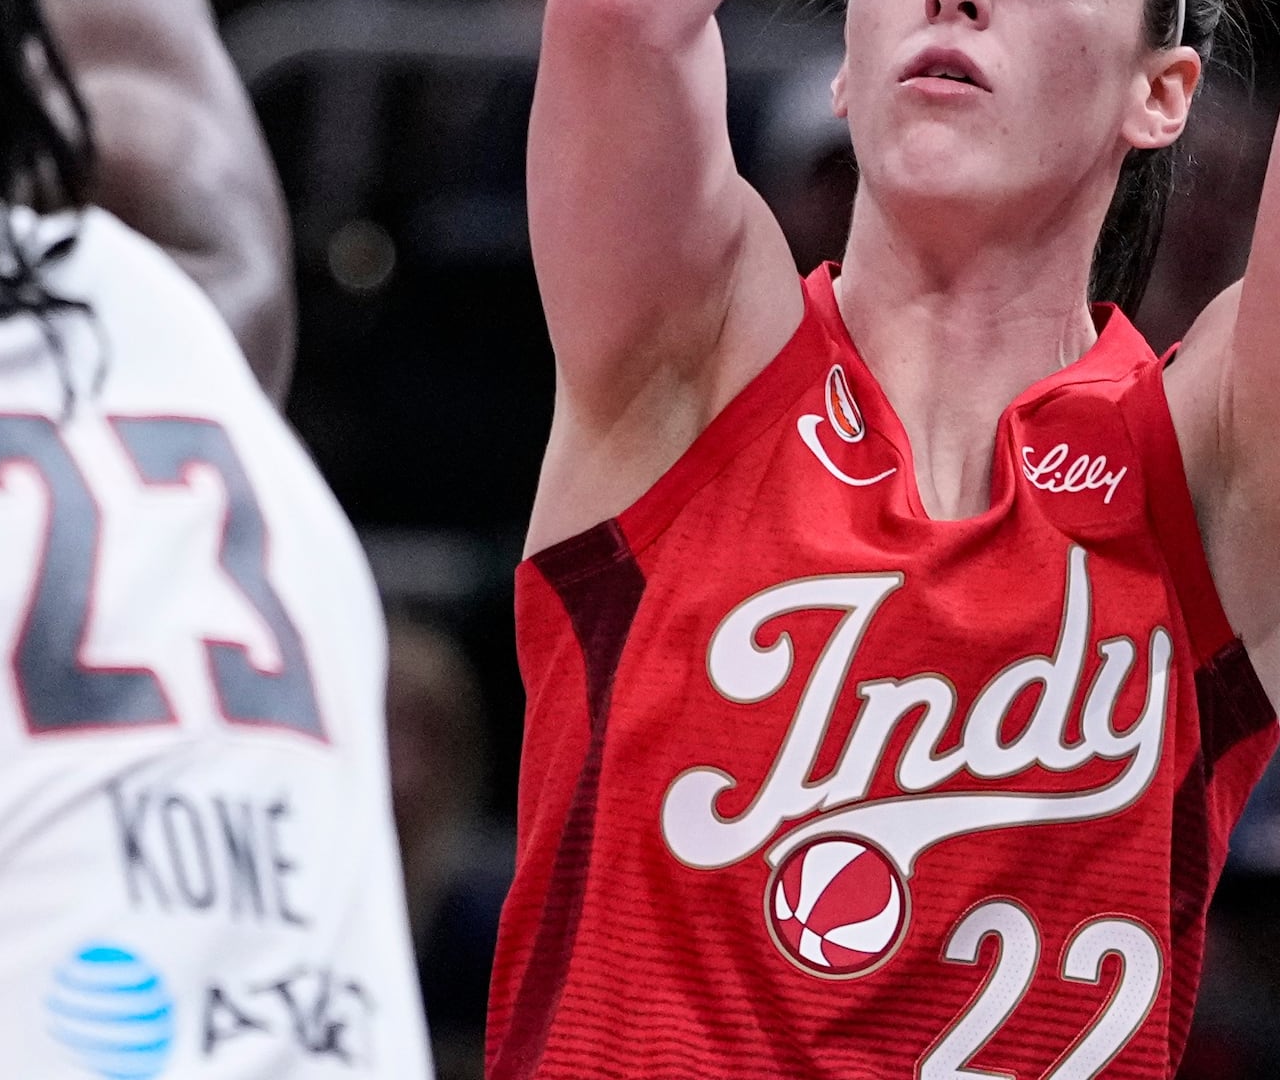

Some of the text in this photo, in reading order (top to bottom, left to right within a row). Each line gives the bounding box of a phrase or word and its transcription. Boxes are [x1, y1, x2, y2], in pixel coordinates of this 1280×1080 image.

[1021, 443, 1127, 504] Lilly
[659, 544, 1174, 877] Indy
[912, 896, 1166, 1080] 22
